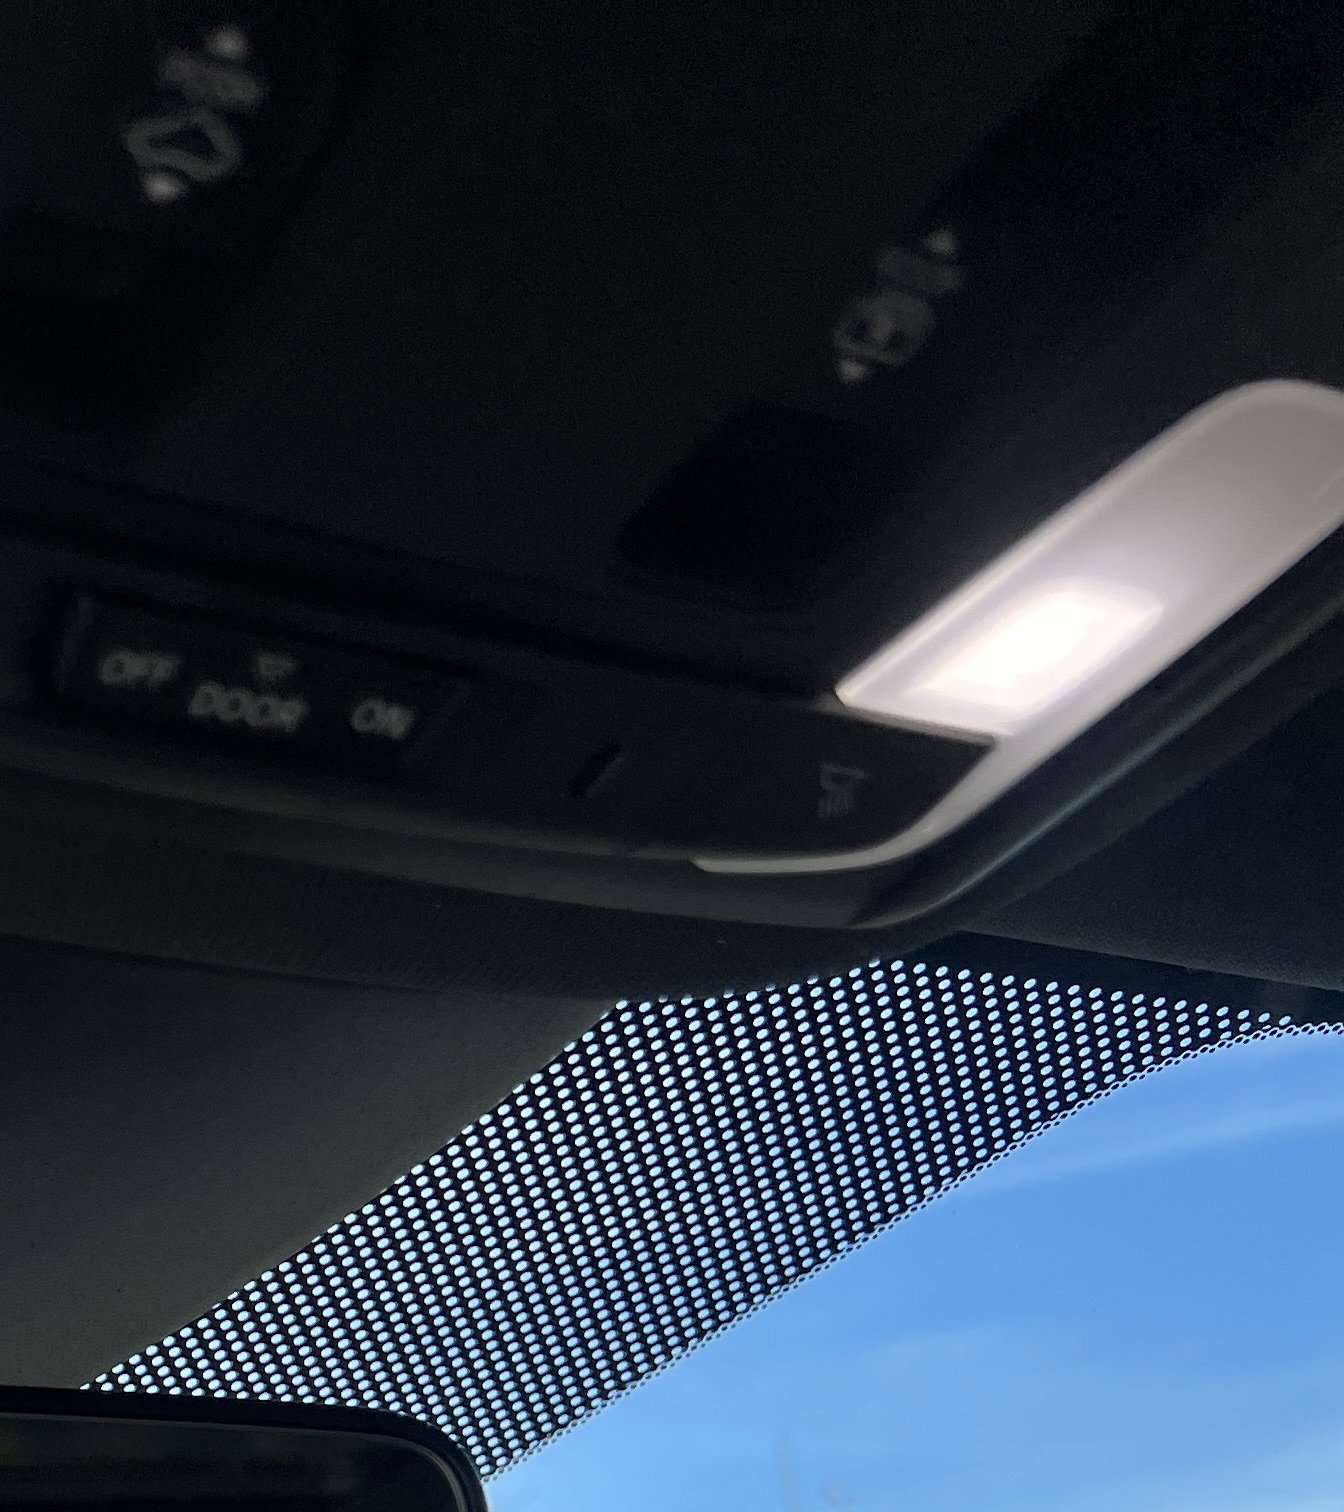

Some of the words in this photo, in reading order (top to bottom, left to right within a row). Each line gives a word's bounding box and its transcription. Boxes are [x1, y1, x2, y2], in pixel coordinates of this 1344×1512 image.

[99, 648, 179, 686] OFF
[188, 682, 306, 729] DOOR
[351, 699, 412, 738] ON
